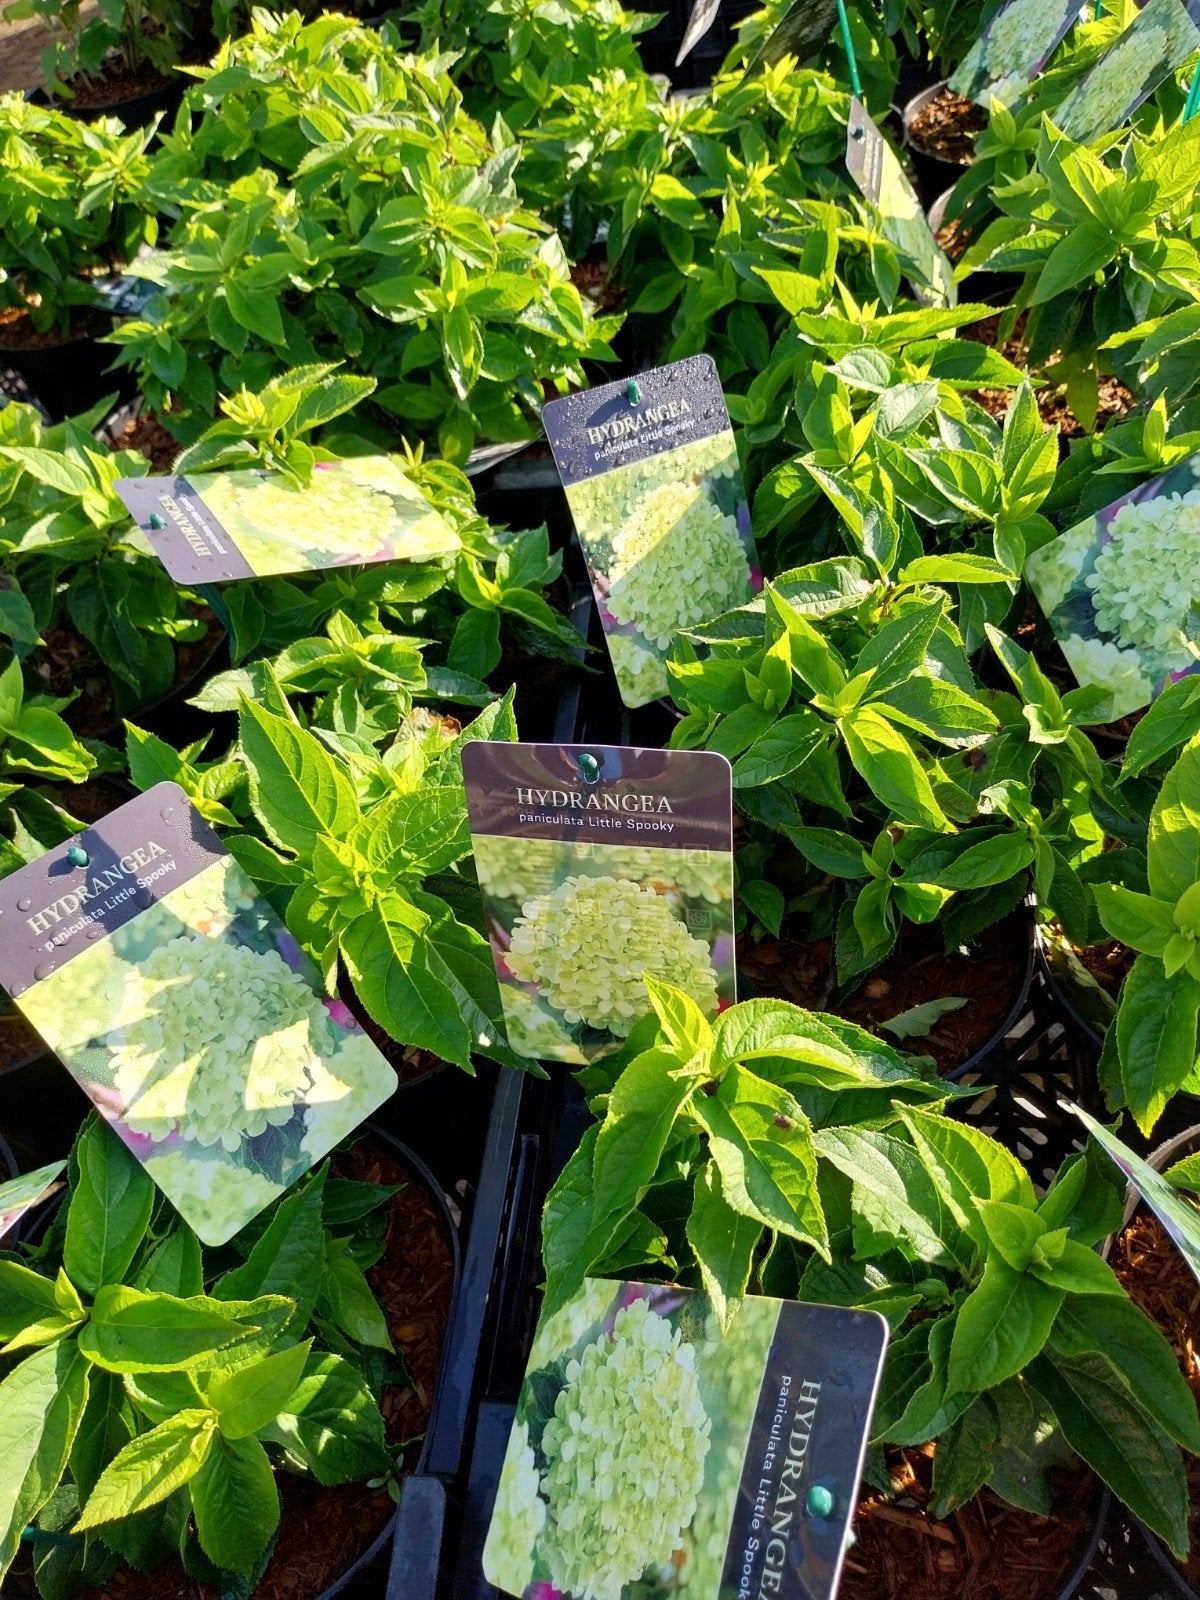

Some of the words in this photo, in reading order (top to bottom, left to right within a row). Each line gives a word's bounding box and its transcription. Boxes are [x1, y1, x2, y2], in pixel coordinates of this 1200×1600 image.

[587, 398, 692, 445] HYDRANGEA
[158, 494, 213, 557] HYDRANGEA
[516, 787, 674, 814] HYDRANGEA
[519, 812, 584, 826] paniculata
[588, 816, 622, 829] Little
[626, 818, 675, 833] Spooky
[26, 840, 168, 936] HYDRANGEA
[44, 908, 106, 952] paniculata
[104, 885, 137, 910] Little
[136, 859, 178, 890] Spooky
[762, 1375, 792, 1470] paniculata
[752, 1478, 772, 1530] Little
